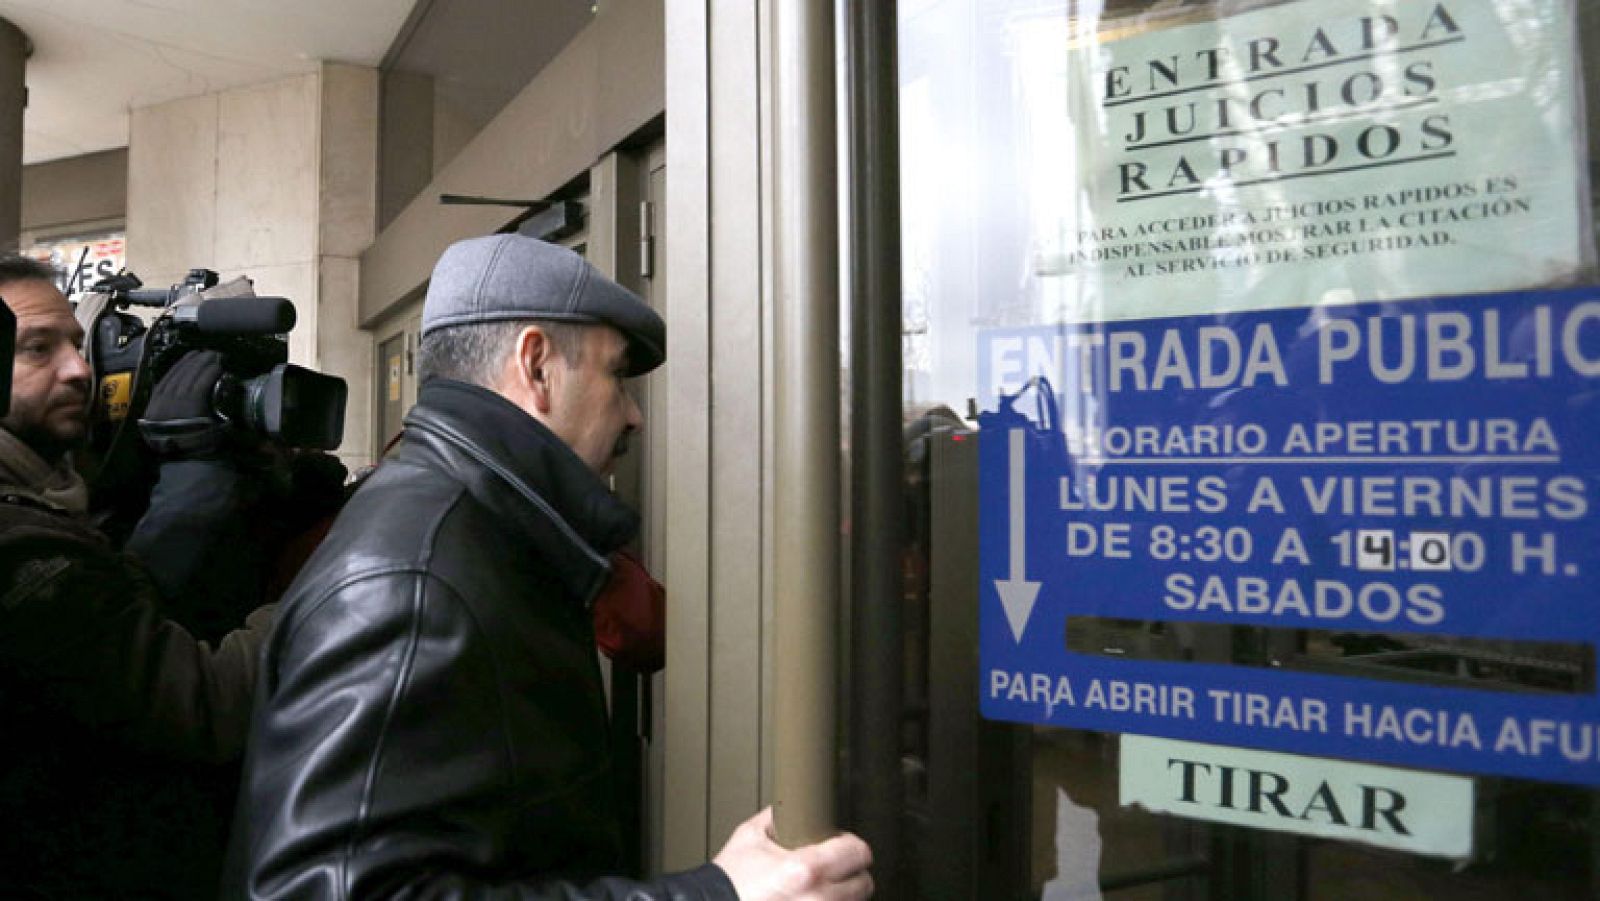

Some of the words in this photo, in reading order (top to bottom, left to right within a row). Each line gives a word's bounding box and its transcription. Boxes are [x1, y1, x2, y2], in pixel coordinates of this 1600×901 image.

[1104, 2, 1463, 99] ENTRADA
[1125, 61, 1438, 145] JUICIOS
[1117, 115, 1456, 195] RAPIDOS
[1077, 226, 1128, 245] PARA
[1134, 212, 1238, 235] ACCEDER
[1240, 209, 1257, 224] A
[1363, 182, 1477, 211] RAPIDOS
[1485, 175, 1518, 195] ES
[1238, 219, 1351, 244] MOSRAR
[1359, 214, 1391, 233] LA
[1124, 262, 1152, 279] AL
[1266, 249, 1298, 264] DE
[990, 322, 1289, 398] ENTRADA
[1282, 417, 1560, 453] APERTURA
[1059, 476, 1228, 513] LUNES
[1248, 476, 1284, 514] A
[1301, 476, 1588, 519] VIERNES
[1067, 522, 1132, 559] DE
[1149, 526, 1253, 562] 8:30
[1272, 526, 1311, 565] A
[1331, 530, 1486, 572] 14:00
[1511, 531, 1578, 576] H.
[1163, 572, 1445, 625] SABADOS
[990, 669, 1075, 707] PARA
[1084, 680, 1195, 718] ABRIR
[1209, 690, 1328, 733] TIRAR
[1344, 705, 1481, 752] HACIA
[1495, 716, 1600, 762] AFU
[1167, 758, 1413, 837] TIRAR
